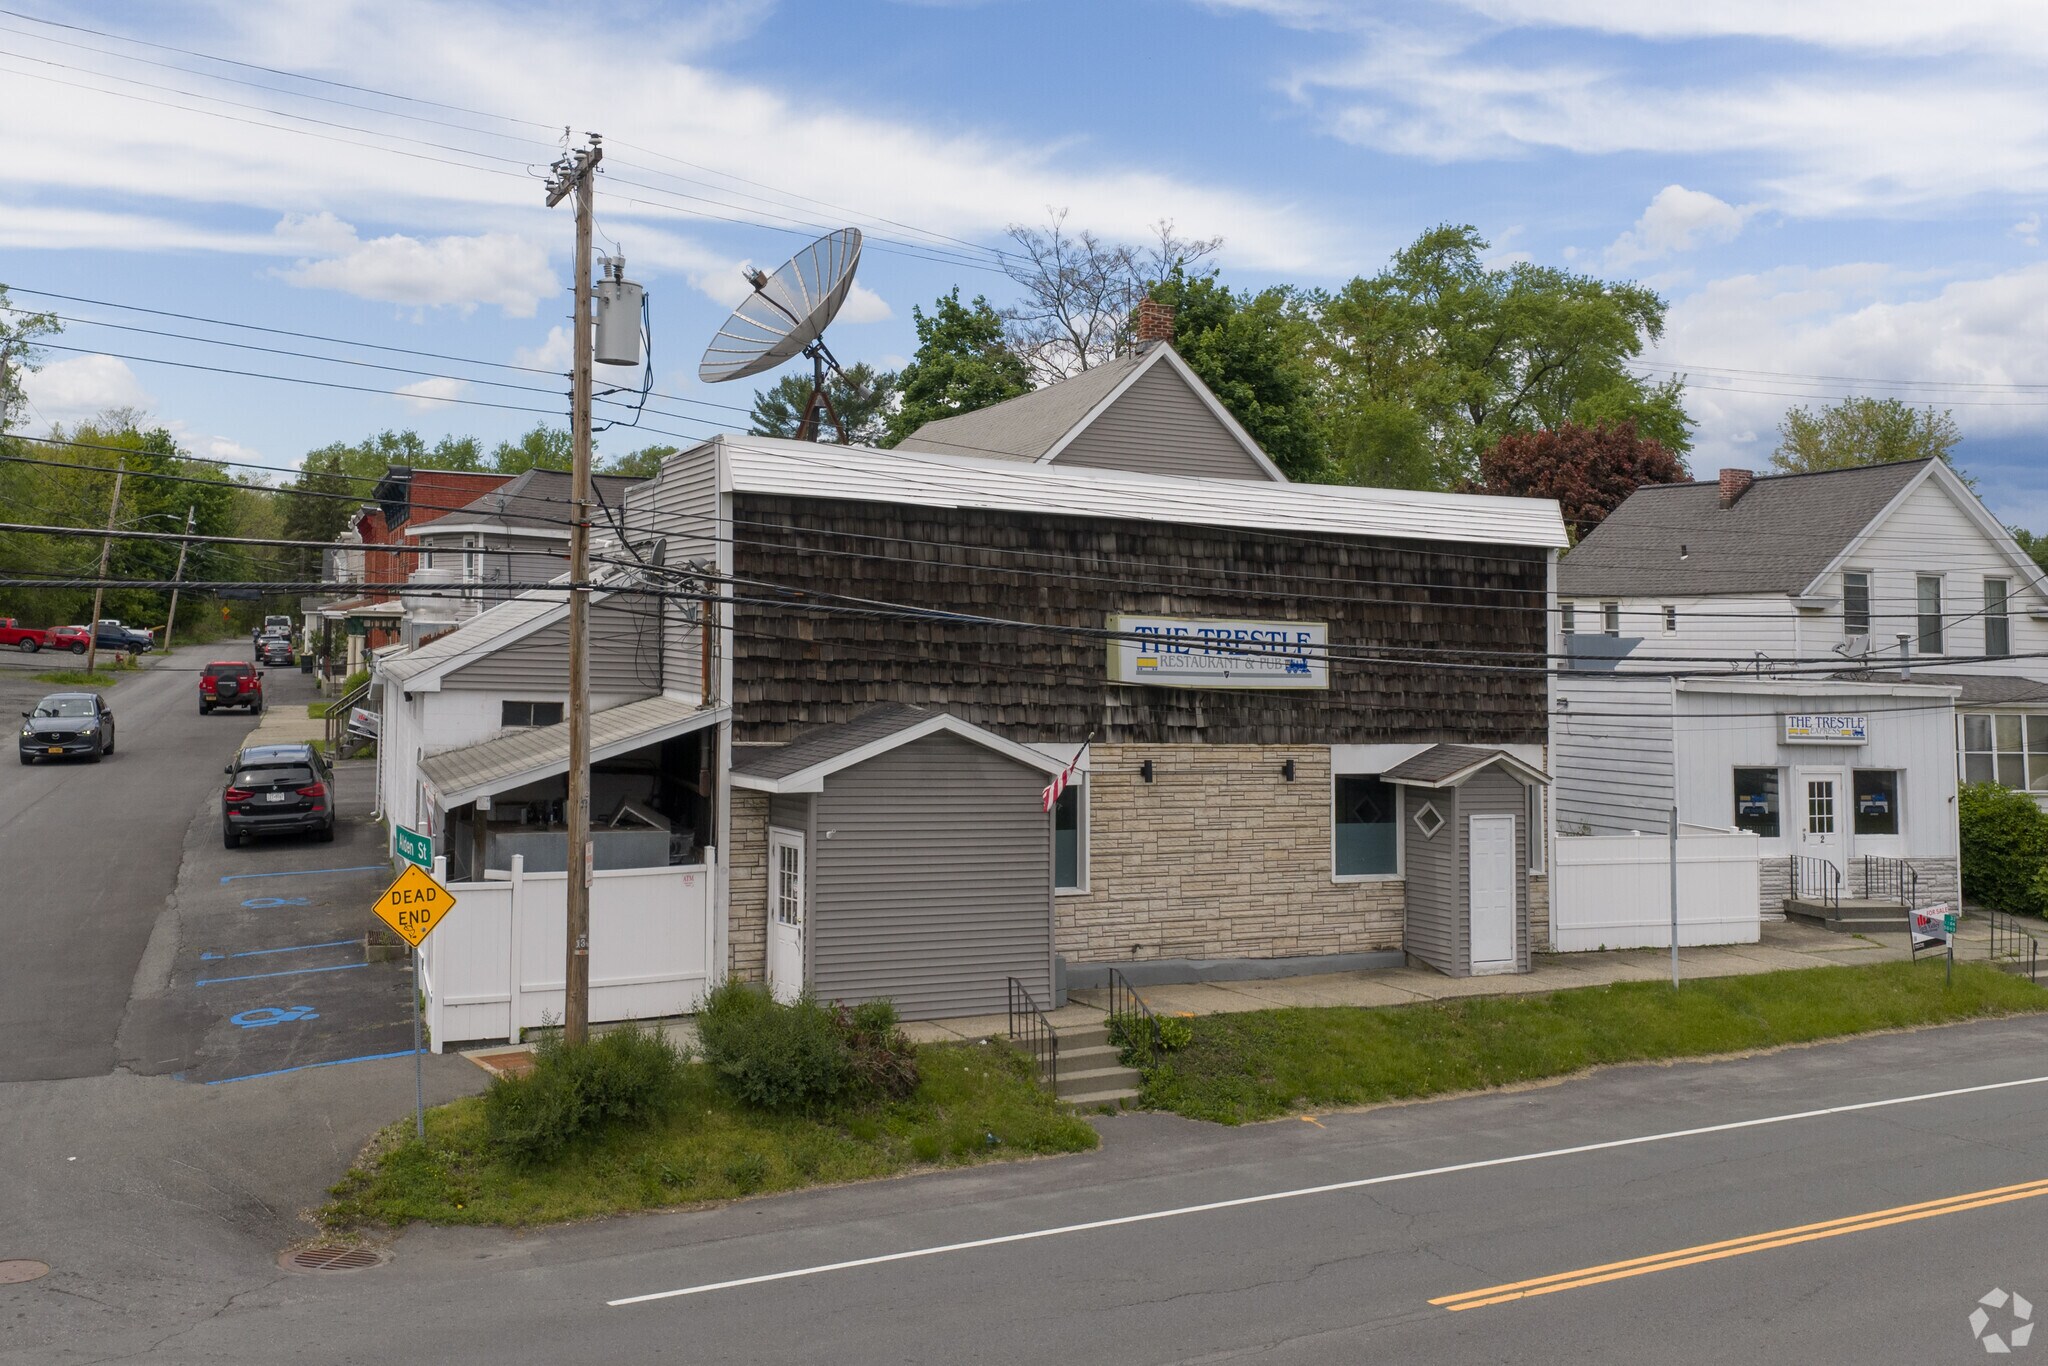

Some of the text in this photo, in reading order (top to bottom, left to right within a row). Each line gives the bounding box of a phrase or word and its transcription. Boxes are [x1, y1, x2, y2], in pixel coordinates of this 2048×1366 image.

[1135, 626, 1313, 656] THE TRESTLE
[1160, 655, 1283, 670] RESTAURANT & PUB
[1788, 716, 1865, 729] THE TRESTLE
[1810, 727, 1841, 735] EXPRESS
[398, 833, 427, 861] Alden St
[1820, 835, 1825, 844] 2
[391, 887, 437, 906] DEAD
[398, 909, 431, 926] END
[1935, 907, 1948, 915] SALE
